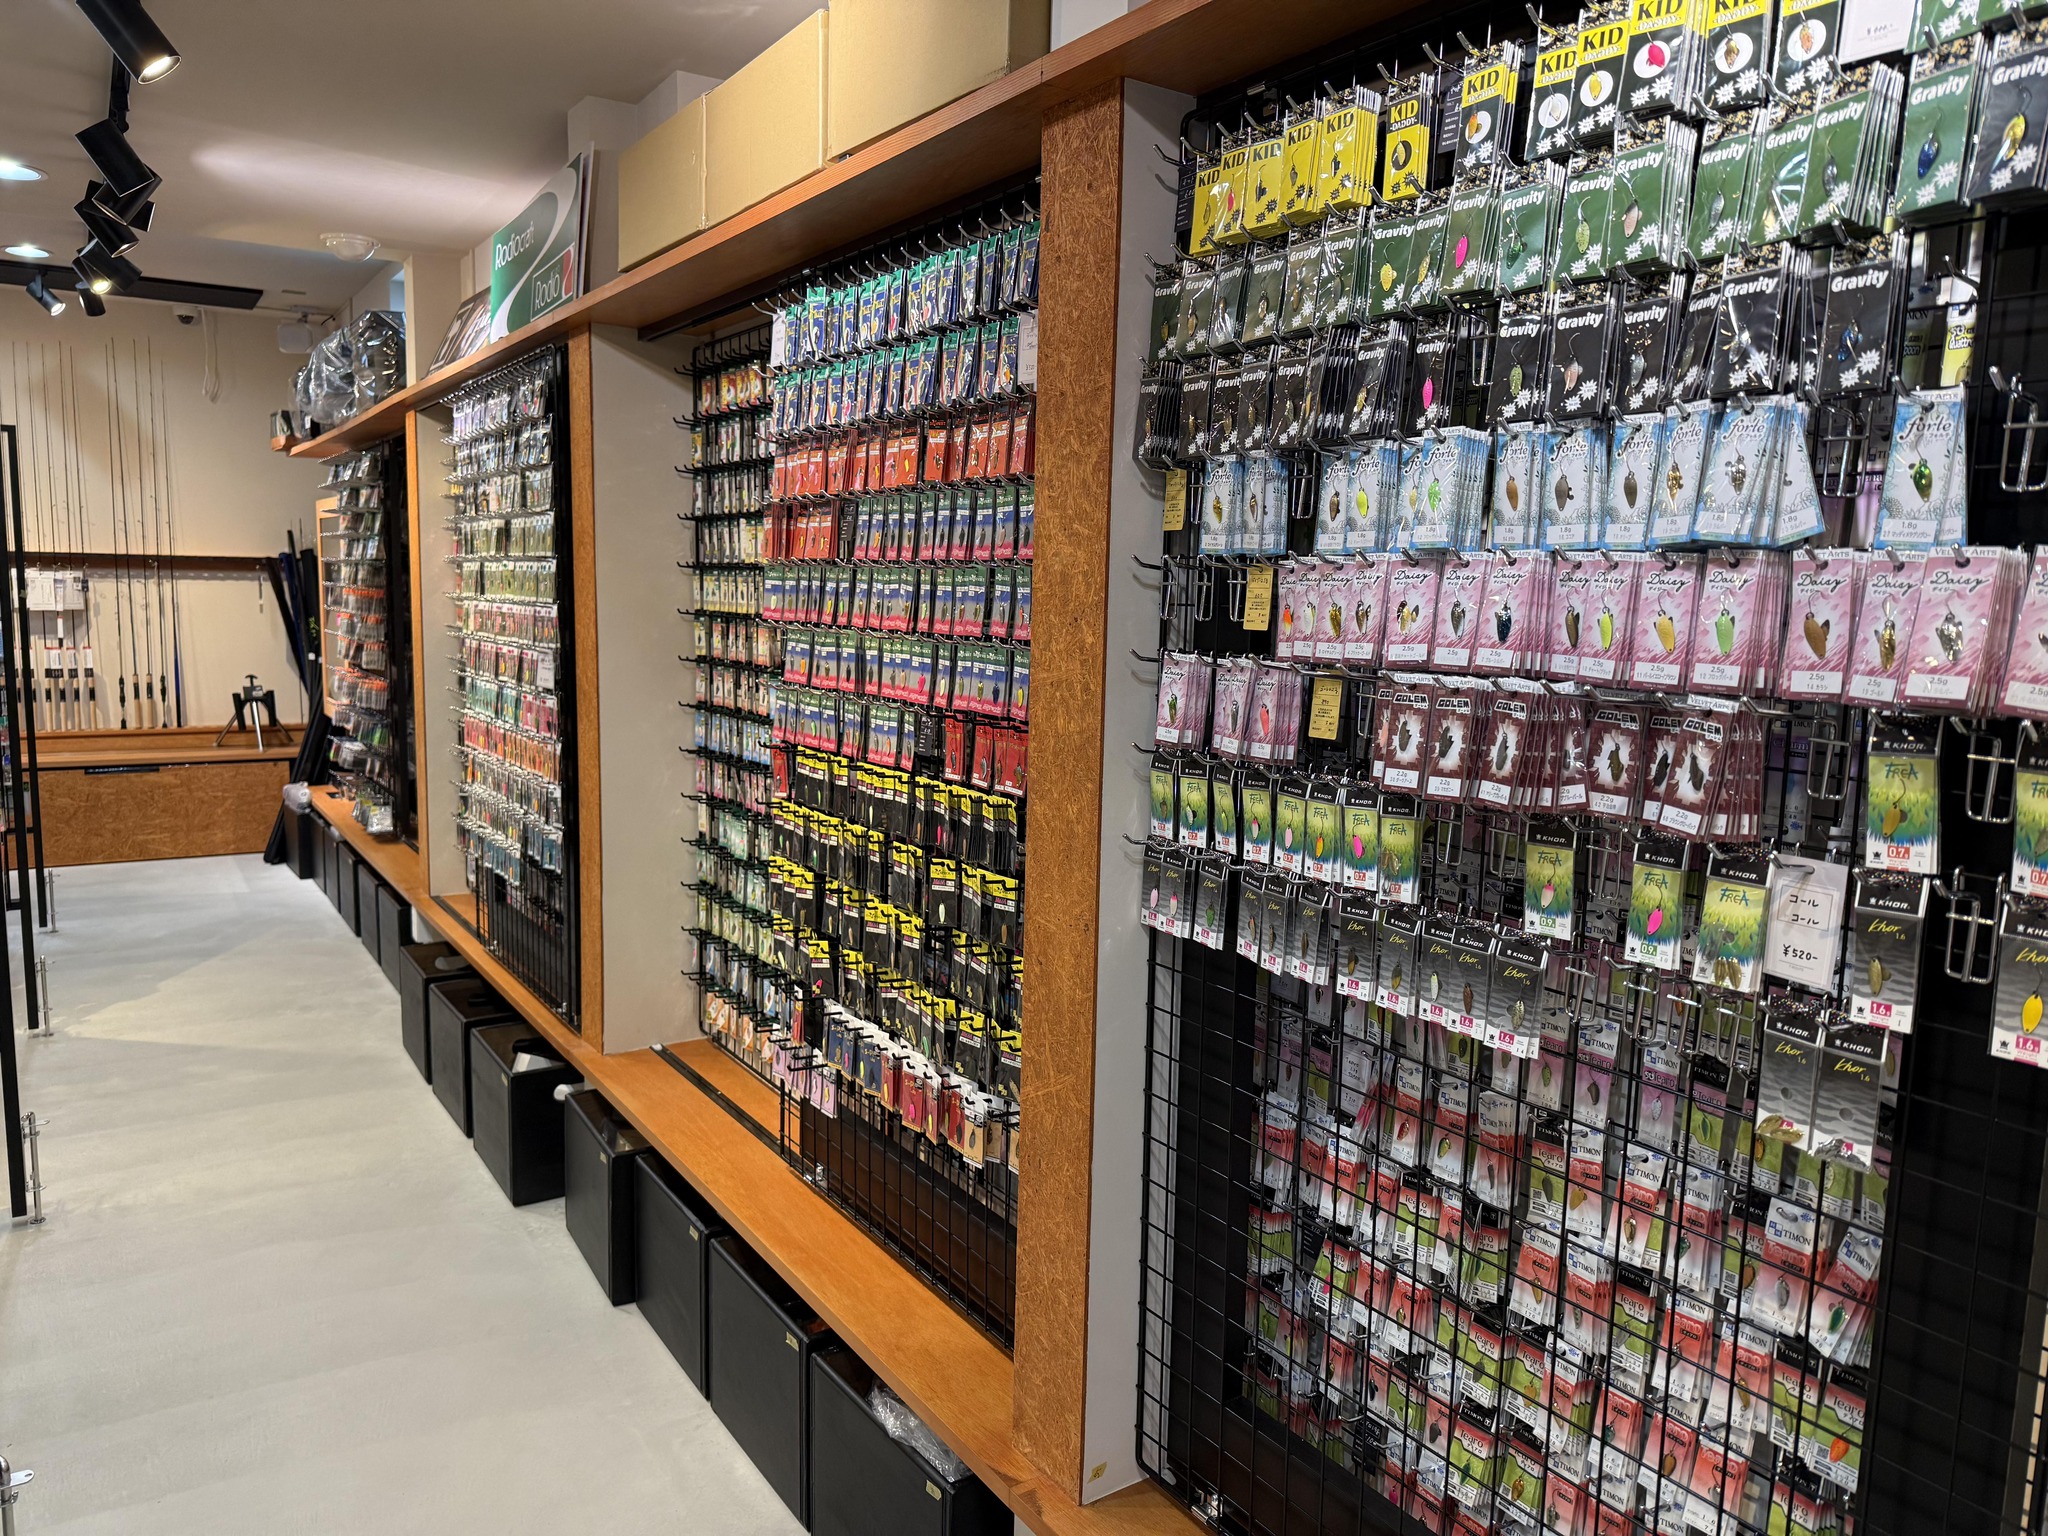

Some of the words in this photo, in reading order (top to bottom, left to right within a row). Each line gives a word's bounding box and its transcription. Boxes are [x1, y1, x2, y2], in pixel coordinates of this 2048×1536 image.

[1637, 0, 1682, 21] KID
[1583, 26, 1623, 51] KID
[1540, 51, 1576, 75] KID
[1991, 53, 2048, 86] Gravity
[1466, 70, 1500, 95] KID
[1911, 74, 1970, 106] Gravity
[1390, 100, 1419, 123] KID
[1816, 100, 1867, 129] Gravity
[1326, 111, 1354, 134] KID
[1287, 125, 1313, 147] KID
[1766, 122, 1811, 149] Gravity
[1222, 151, 1246, 171] KID
[1253, 142, 1282, 163] KID
[1701, 141, 1747, 165] Gravity
[1617, 150, 1663, 174] Gravity
[1198, 169, 1220, 188] KID
[1568, 175, 1613, 194] Gravity
[1453, 190, 1489, 211] Gravity
[1503, 189, 1545, 212] Gravity
[1416, 213, 1446, 230] Gravity
[1374, 224, 1415, 240] Gravity
[1220, 265, 1241, 282] Gravity
[1254, 258, 1284, 274] Gravity
[1724, 275, 1778, 298] Gravity
[1831, 268, 1889, 293] Gravity
[534, 271, 561, 312] Rodio
[1557, 312, 1604, 330] Gravity
[1624, 305, 1667, 325] Gravity
[1500, 323, 1540, 338] Gravity
[1358, 346, 1385, 362] Gravity
[1416, 340, 1446, 354] Gravity
[1242, 369, 1267, 382] Gravity
[1723, 418, 1765, 440] forte
[1898, 416, 1952, 441] forte
[1668, 426, 1702, 449] forte
[1499, 442, 1527, 463] forte
[1617, 435, 1653, 458] forte
[1424, 447, 1456, 467] forte
[1352, 456, 1380, 476] forte
[1207, 468, 1232, 486] forte
[1902, 521, 1918, 530] 1.8g
[1323, 572, 1353, 587] Daisy
[1394, 569, 1432, 585] Daisy
[1446, 569, 1480, 586] Daisy
[1493, 568, 1527, 585] Daisy
[1559, 571, 1591, 589] Daisy
[1594, 571, 1628, 589] Daisy
[1647, 573, 1690, 592] Daisy
[1797, 573, 1847, 593] Daisy
[1872, 574, 1919, 596] Daisy
[1930, 570, 1990, 593] Daisy
[1650, 665, 1665, 673] 2.5g
[1711, 666, 1725, 674] 2.5g
[1809, 673, 1825, 681] 2.5g
[1394, 694, 1428, 704] GOLEM
[1438, 699, 1471, 709] GOLEM
[1495, 701, 1527, 714] GOLEM
[1597, 711, 1638, 724] GOLEM
[1684, 718, 1722, 737] GOLEM
[1892, 742, 1924, 751] KHOR
[1601, 795, 1614, 803] 2.2g
[1541, 835, 1566, 844] KHOR
[1651, 854, 1675, 864] KHOR
[1728, 869, 1757, 880] KHOR
[1720, 886, 1750, 907] FREA
[1789, 894, 1819, 908] コール
[1878, 899, 1909, 910] KHOR
[1792, 913, 1820, 926] コール
[1592, 924, 1613, 937] TIMON
[1465, 938, 1485, 949] KHOR
[1512, 951, 1536, 962] KHOR
[1782, 944, 1818, 961] ¥520-
[1547, 1022, 1567, 1034] TIMON
[1783, 1024, 1809, 1038] KHOR
[1591, 1038, 1614, 1051] TIMON
[1843, 1041, 1872, 1055] KHOR
[1656, 1056, 1678, 1069] TIMON
[1449, 1097, 1467, 1109] TIMON
[1337, 1145, 1356, 1158] TIMON
[1537, 1149, 1564, 1163] Tearo
[1578, 1145, 1601, 1156] TIMON
[1635, 1169, 1660, 1183] TIMON
[1687, 1189, 1710, 1203] TIMON
[1536, 1234, 1557, 1250] TIMON
[1783, 1229, 1812, 1247] TIMON
[1577, 1261, 1596, 1276] TIMON
[1852, 1250, 1872, 1271] TIMON
[1620, 1292, 1645, 1311] Tearo
[1681, 1299, 1706, 1315] TIMON
[1474, 1331, 1496, 1350] Tearo
[1740, 1330, 1768, 1348] TIMON
[1556, 1359, 1577, 1377] TIMON
[1613, 1379, 1637, 1394] TIMON
[1670, 1406, 1692, 1423] TIMON
[1834, 1394, 1866, 1418] Tearo
[1559, 1460, 1580, 1478] TIMON
[1602, 1489, 1624, 1505] TIMON
